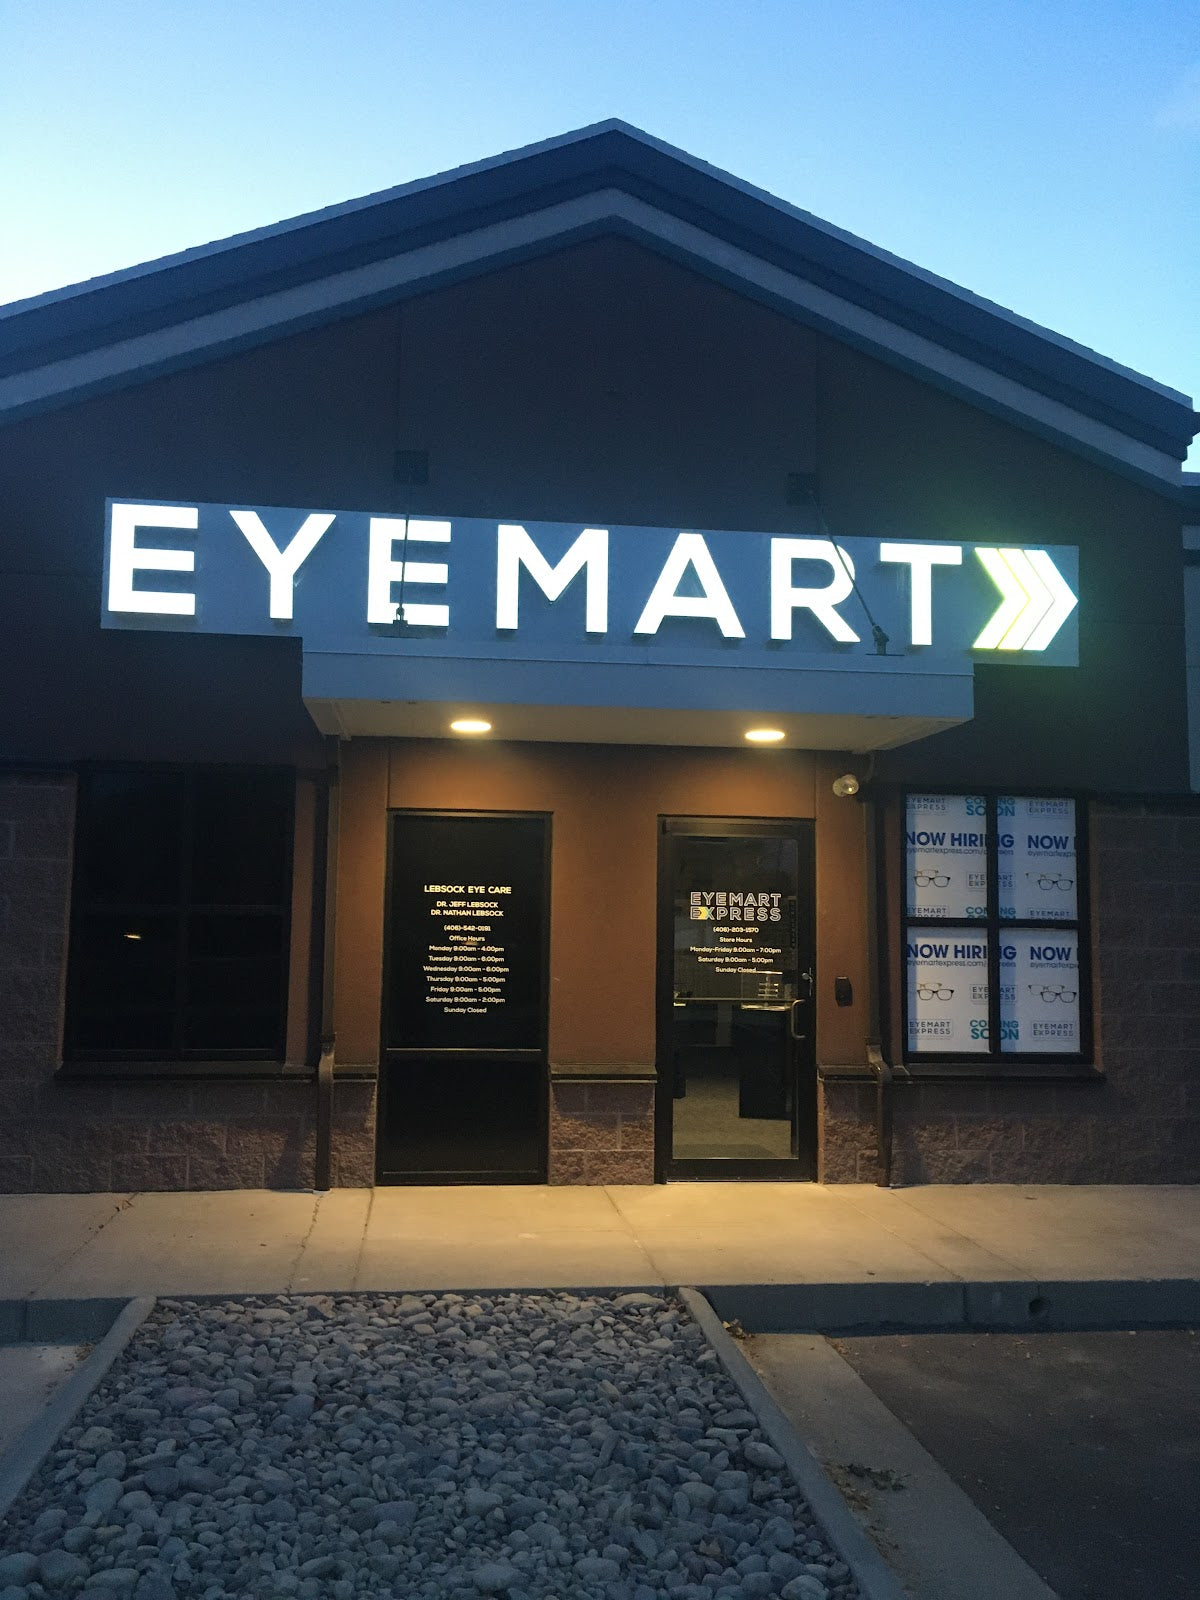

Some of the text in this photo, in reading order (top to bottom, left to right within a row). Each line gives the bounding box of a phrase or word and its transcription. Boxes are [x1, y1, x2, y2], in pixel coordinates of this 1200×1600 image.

[107, 502, 965, 646] EYEMART
[907, 832, 946, 846] NOW
[1028, 835, 1069, 850] NOW
[424, 885, 465, 893] LEBSOCK
[488, 886, 512, 894] CARE
[690, 891, 782, 907] EYEMART
[690, 906, 782, 921] EXPRESS
[966, 907, 1016, 915] CONG
[1030, 909, 1070, 917] EYEMART
[689, 946, 732, 954] Monday-Friday
[907, 944, 949, 959] NOW
[1030, 946, 1072, 961] NOW
[715, 966, 737, 974] Sunday
[969, 1020, 1019, 1029] CONG
